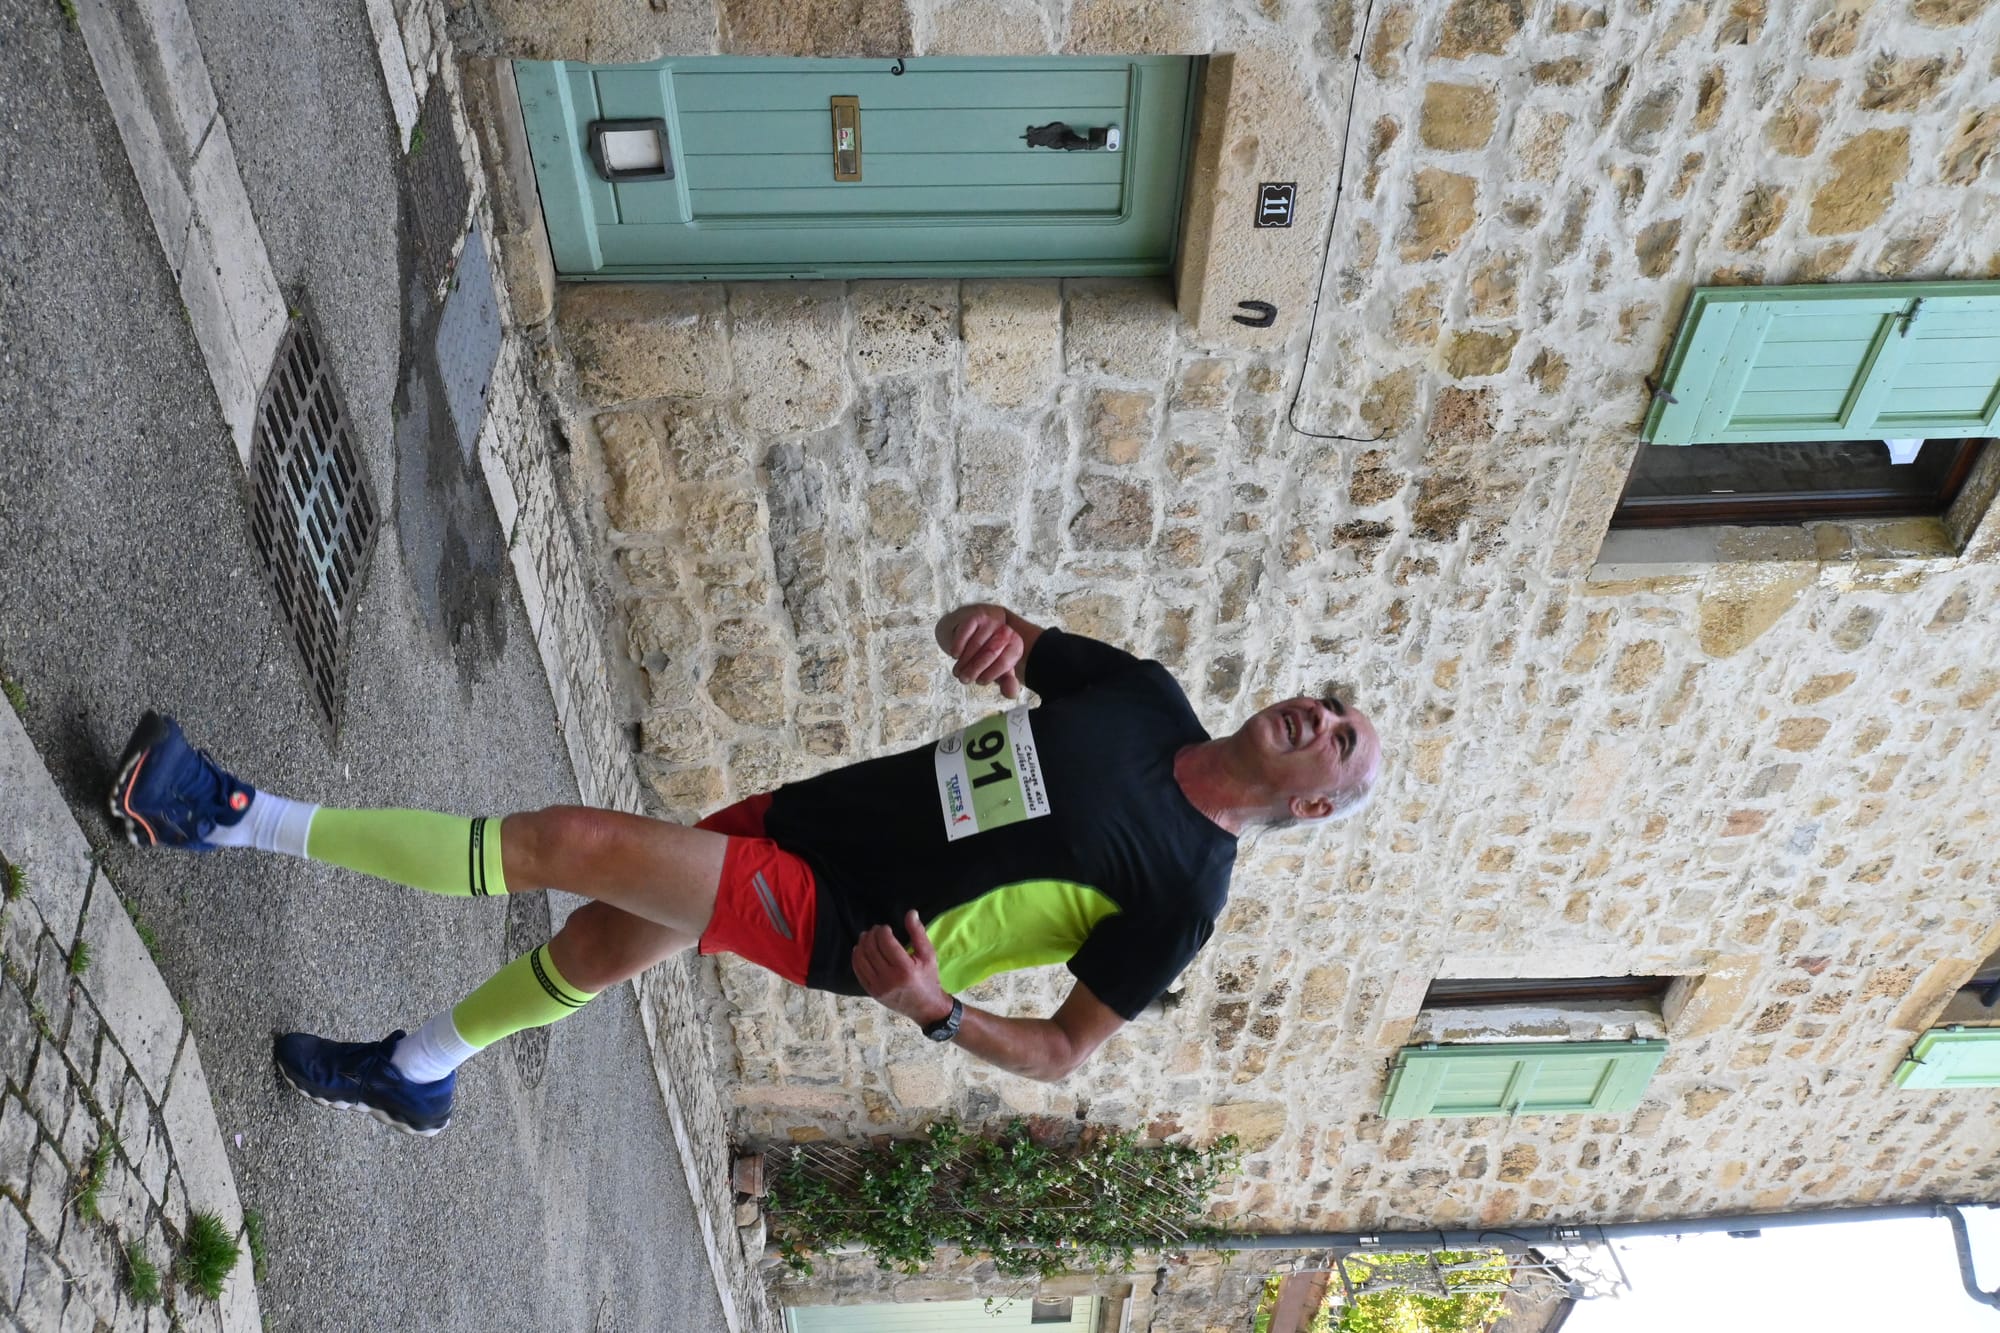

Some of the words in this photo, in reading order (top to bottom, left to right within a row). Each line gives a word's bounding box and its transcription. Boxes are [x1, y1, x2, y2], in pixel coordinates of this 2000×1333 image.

[1263, 196, 1289, 216] 11
[966, 730, 1012, 789] 91
[1024, 745, 1039, 787] Challenge
[1035, 790, 1044, 805] des
[950, 773, 964, 812] TUFF'S
